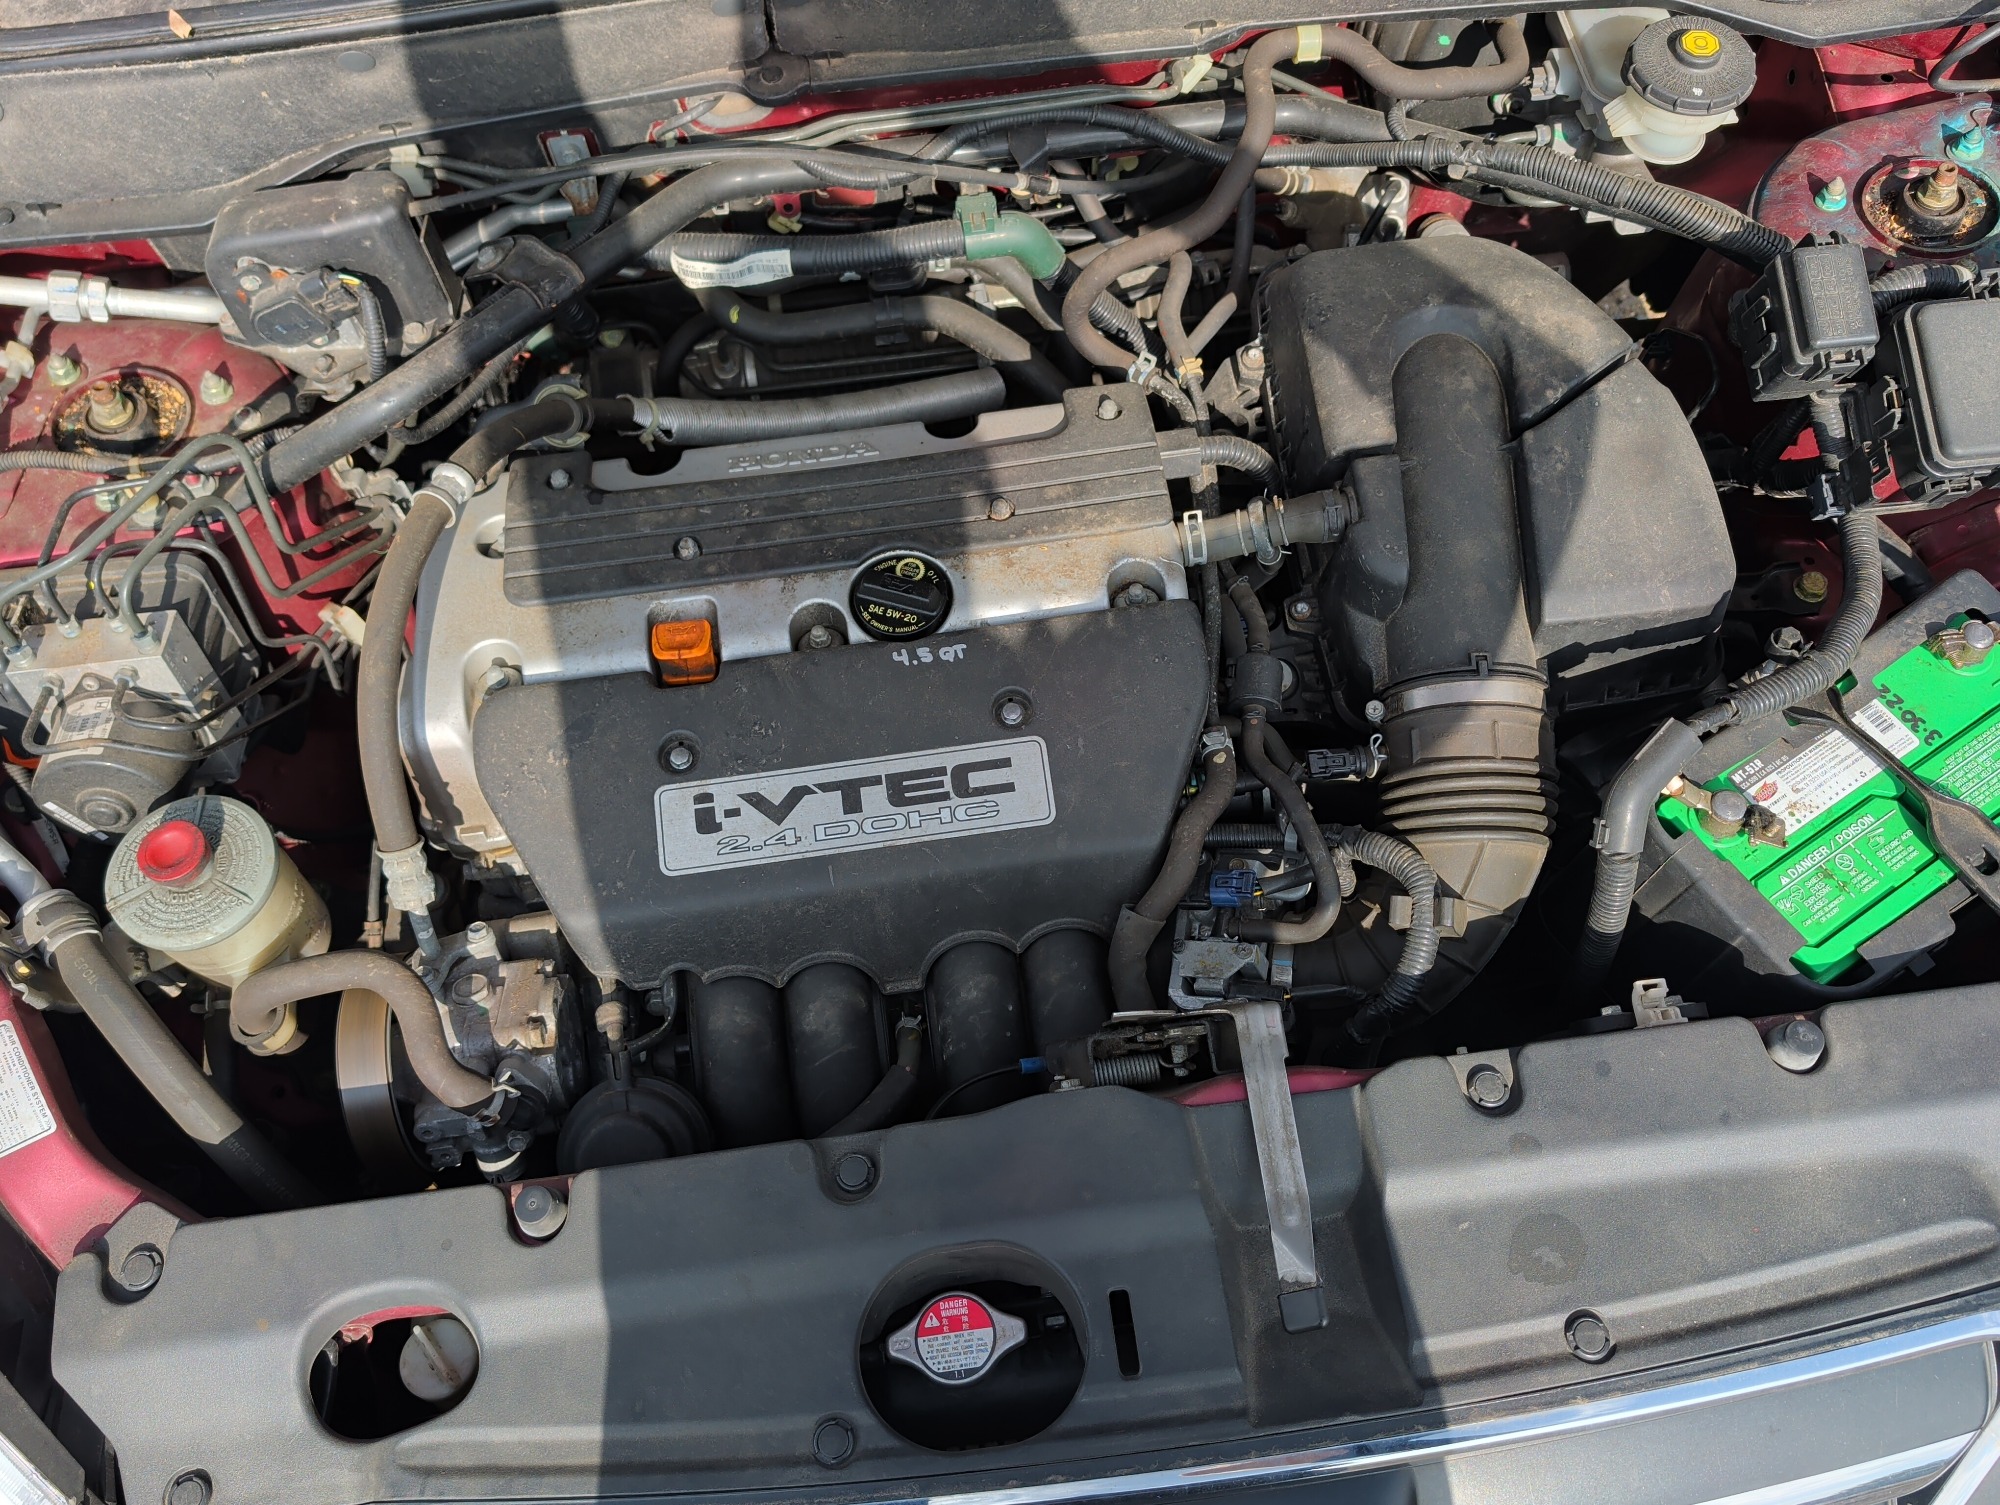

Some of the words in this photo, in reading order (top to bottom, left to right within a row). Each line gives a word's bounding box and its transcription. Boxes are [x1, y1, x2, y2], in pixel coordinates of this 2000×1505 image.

[728, 442, 880, 473] HONDA
[874, 560, 897, 572] ENGINE
[927, 570, 940, 584] OIL
[862, 611, 872, 622] SEE
[870, 617, 893, 633] OWNER'S
[895, 624, 919, 633] MANUAL
[868, 604, 885, 615] SAE
[886, 609, 917, 623] 5W-20
[892, 647, 934, 666] 4.5
[939, 643, 967, 662] QT
[1775, 755, 1804, 776] PROPOSITION
[1807, 738, 1828, 754] WARNING
[1962, 760, 1978, 772] EYES
[1730, 757, 1765, 784] MT-51R
[1952, 775, 1968, 787] WITH
[1982, 756, 1995, 766] GET
[1958, 776, 1980, 793] MEDICAL
[1978, 766, 1994, 779] HELP
[1738, 779, 1751, 790] CCA
[693, 757, 1016, 835] i-VTEC
[717, 827, 802, 856] 2.4
[814, 800, 1001, 843] DOHC
[1786, 845, 1831, 878] DANGER
[1833, 813, 1876, 845] POISON
[1874, 837, 1901, 858] SULFURIC
[1898, 828, 1915, 841] ACID
[1880, 852, 1892, 862] CAN
[1889, 844, 1905, 856] CAUSE
[1885, 849, 1908, 867] BLINDNESS
[1848, 867, 1860, 876] NO
[1889, 858, 1907, 871] SEVERE
[1802, 871, 1825, 888] SHIELD
[1849, 870, 1868, 884] SPARKS
[1854, 874, 1873, 889] FLAMES
[1859, 877, 1880, 894] SMOKING
[164, 888, 202, 903] NOTICE
[1802, 883, 1833, 907] EXPLOSIVE
[1808, 879, 1826, 894] EYES
[166, 901, 194, 913] HONDA
[1801, 917, 1813, 927] CAN
[1809, 909, 1825, 921] CAUSE
[1822, 894, 1846, 912] BLINDNESS
[1807, 896, 1829, 913] GASES
[1818, 915, 1827, 923] OR
[1824, 905, 1840, 918] INJURY
[6, 1033, 16, 1046] AIR
[11, 1045, 36, 1091] CONDITIONER
[31, 1090, 48, 1119] SYSTEM
[940, 1299, 967, 1310] DANGER
[941, 1307, 969, 1318] WARNUNG
[954, 1370, 965, 1379] 1.1
